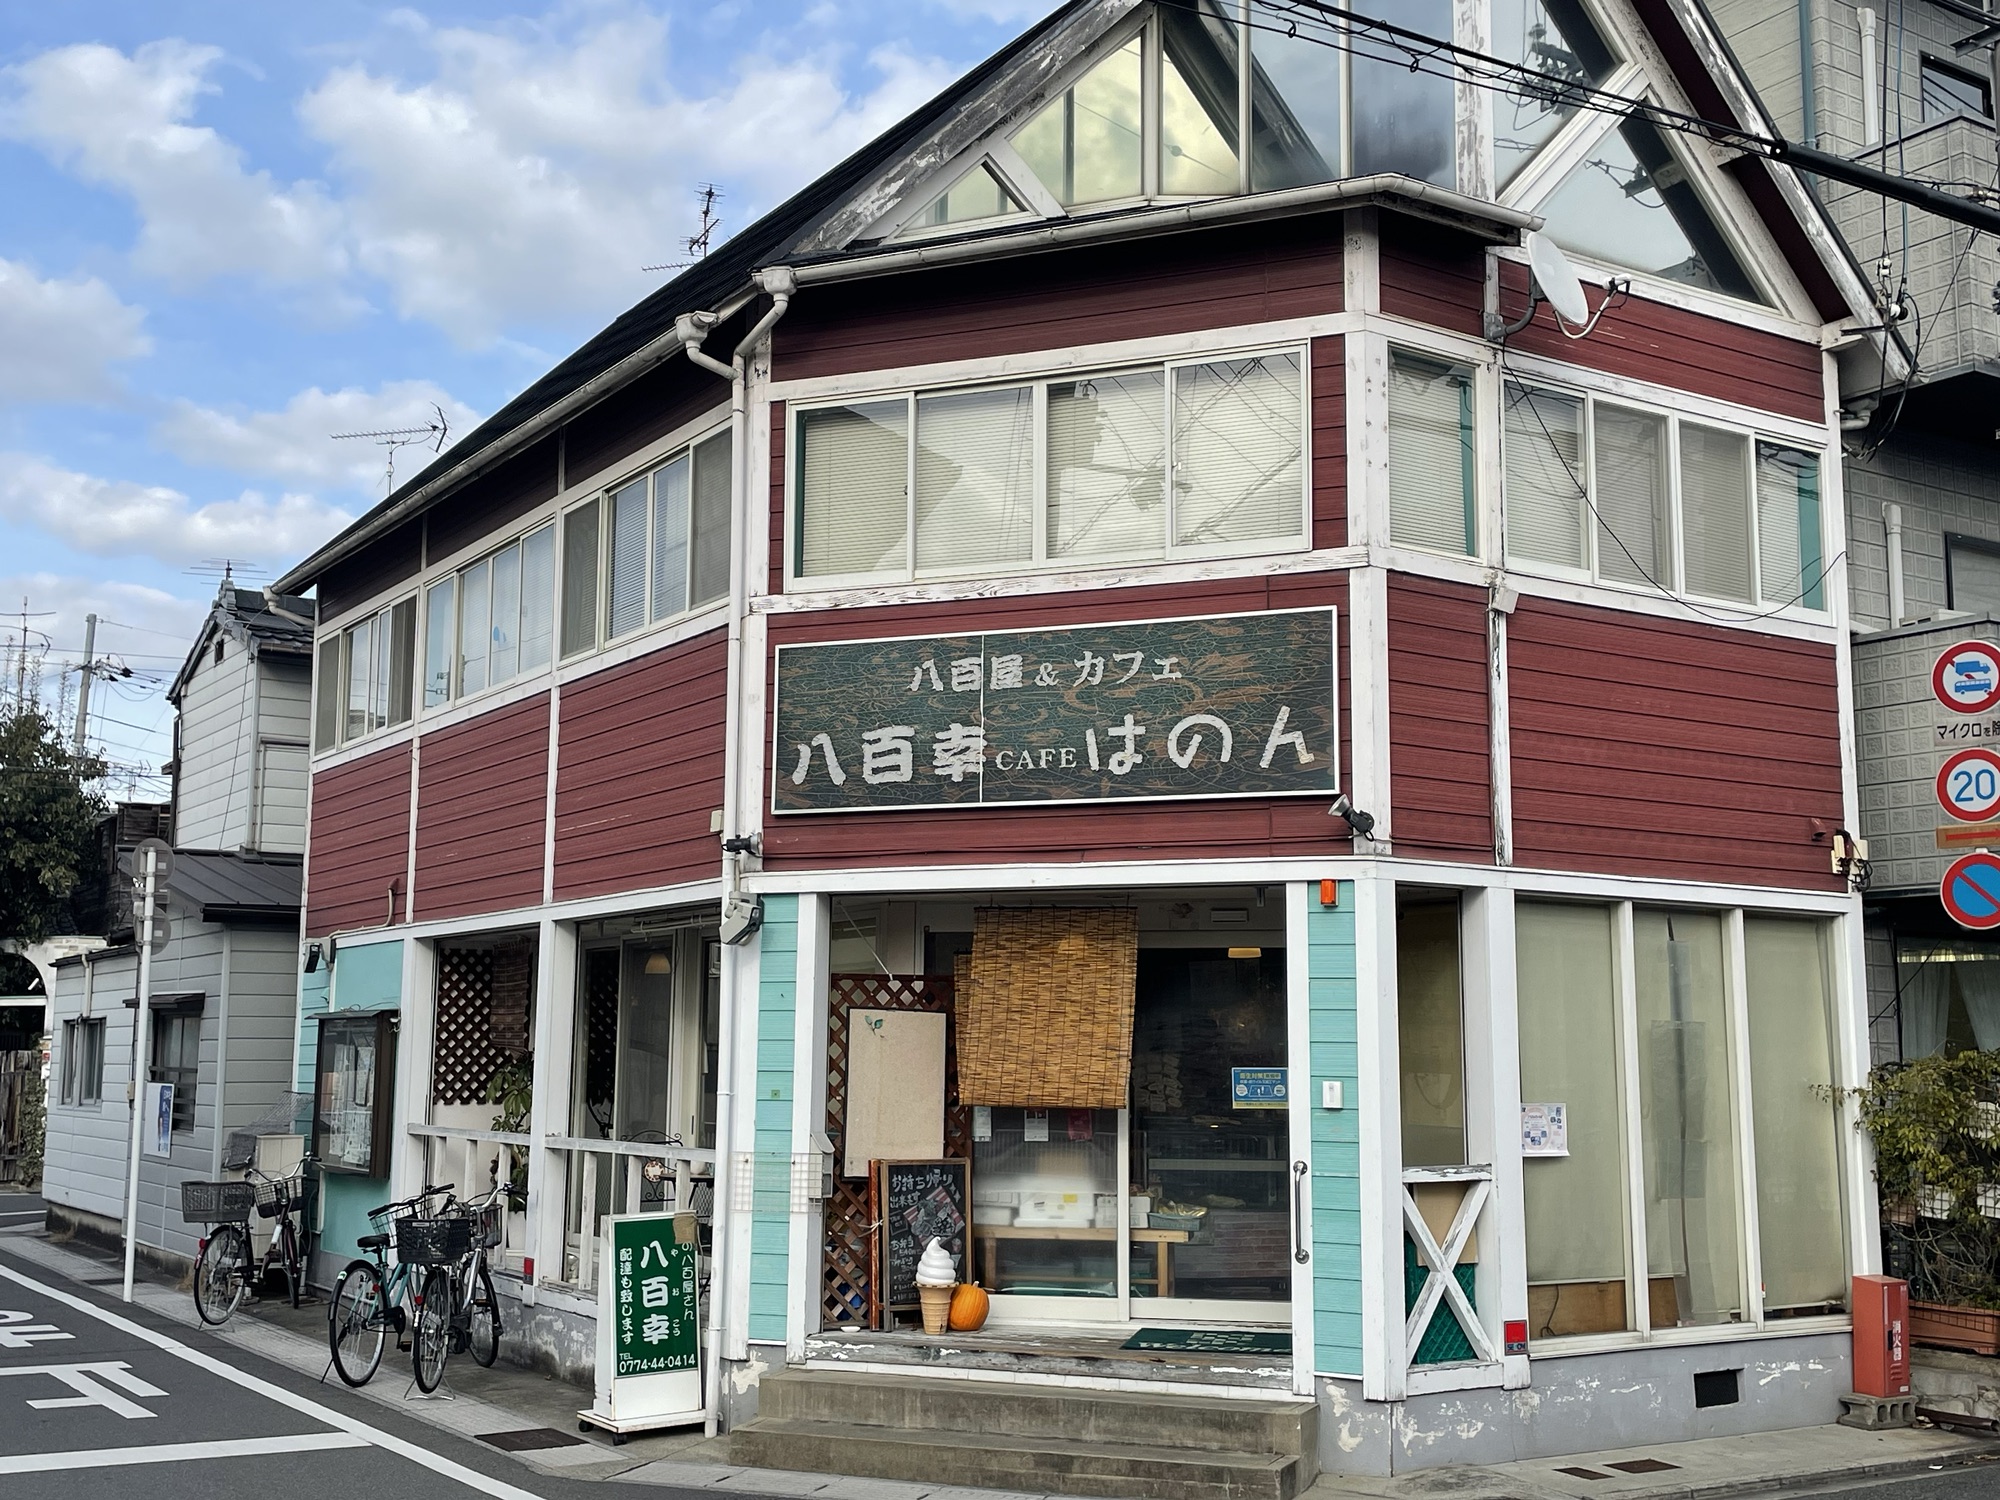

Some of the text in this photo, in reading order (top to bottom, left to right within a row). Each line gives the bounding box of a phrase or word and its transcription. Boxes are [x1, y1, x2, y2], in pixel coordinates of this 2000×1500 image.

[910, 650, 1183, 692] 八百屋 & カフェ
[791, 705, 1316, 785] 八百幸 CAFE はのん
[1954, 768, 1996, 803] 20
[892, 1169, 953, 1192] お持ち帰り
[619, 1248, 634, 1345] 配達も致します
[640, 1240, 670, 1345] 八百幸
[619, 1352, 633, 1360] TEL
